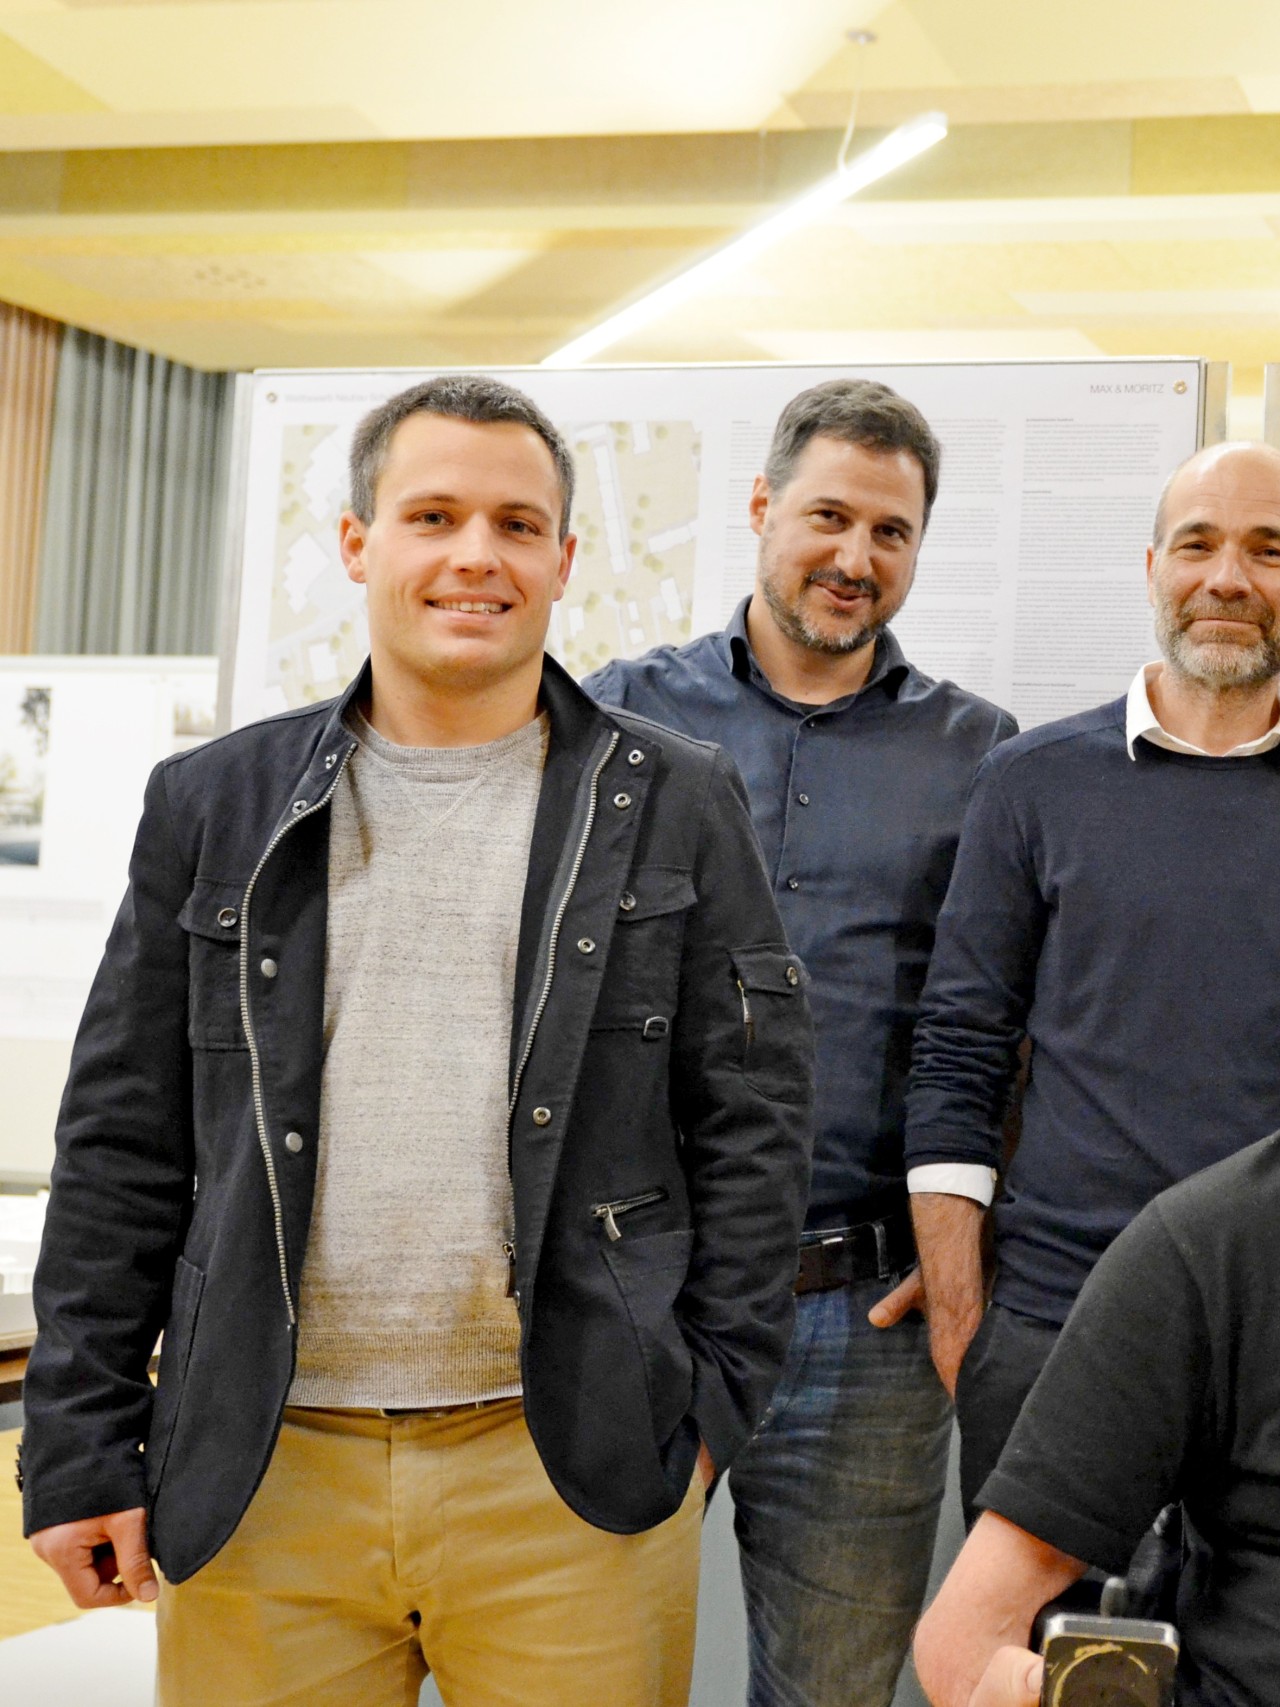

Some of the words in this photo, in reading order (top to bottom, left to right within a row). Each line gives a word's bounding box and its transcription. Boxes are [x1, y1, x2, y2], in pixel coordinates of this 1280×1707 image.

[1090, 383, 1112, 394] MAX
[1114, 383, 1122, 394] &
[1124, 383, 1165, 394] MORITZ
